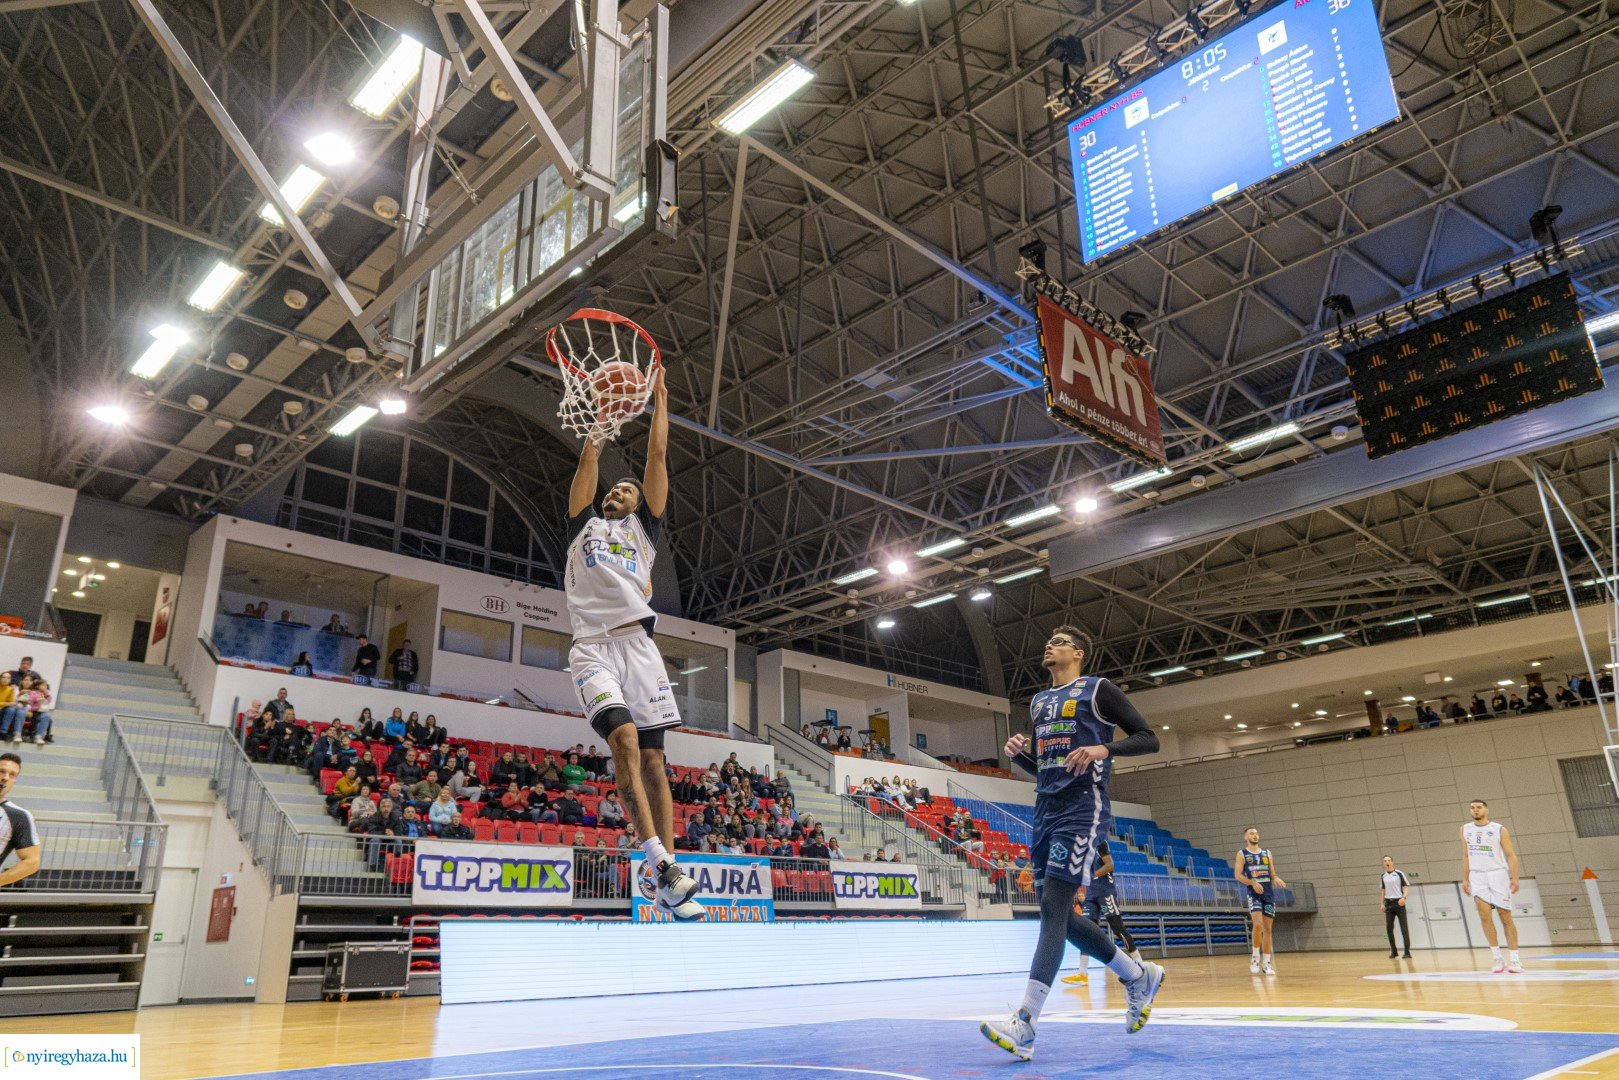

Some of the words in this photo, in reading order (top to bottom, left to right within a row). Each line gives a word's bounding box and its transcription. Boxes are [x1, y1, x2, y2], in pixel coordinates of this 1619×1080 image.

[1182, 42, 1226, 79] 8:05
[1202, 80, 1209, 91] 2
[1079, 130, 1096, 152] 30
[1059, 390, 1078, 413] Ahol
[1080, 404, 1086, 415] a
[1087, 406, 1110, 427] pénze
[1112, 420, 1137, 442] többet
[1138, 434, 1148, 448] ér!
[486, 598, 504, 612] BH
[516, 601, 532, 610] Bige
[532, 605, 558, 616] Holding
[523, 612, 551, 622] Csoport
[1044, 703, 1058, 720] 31
